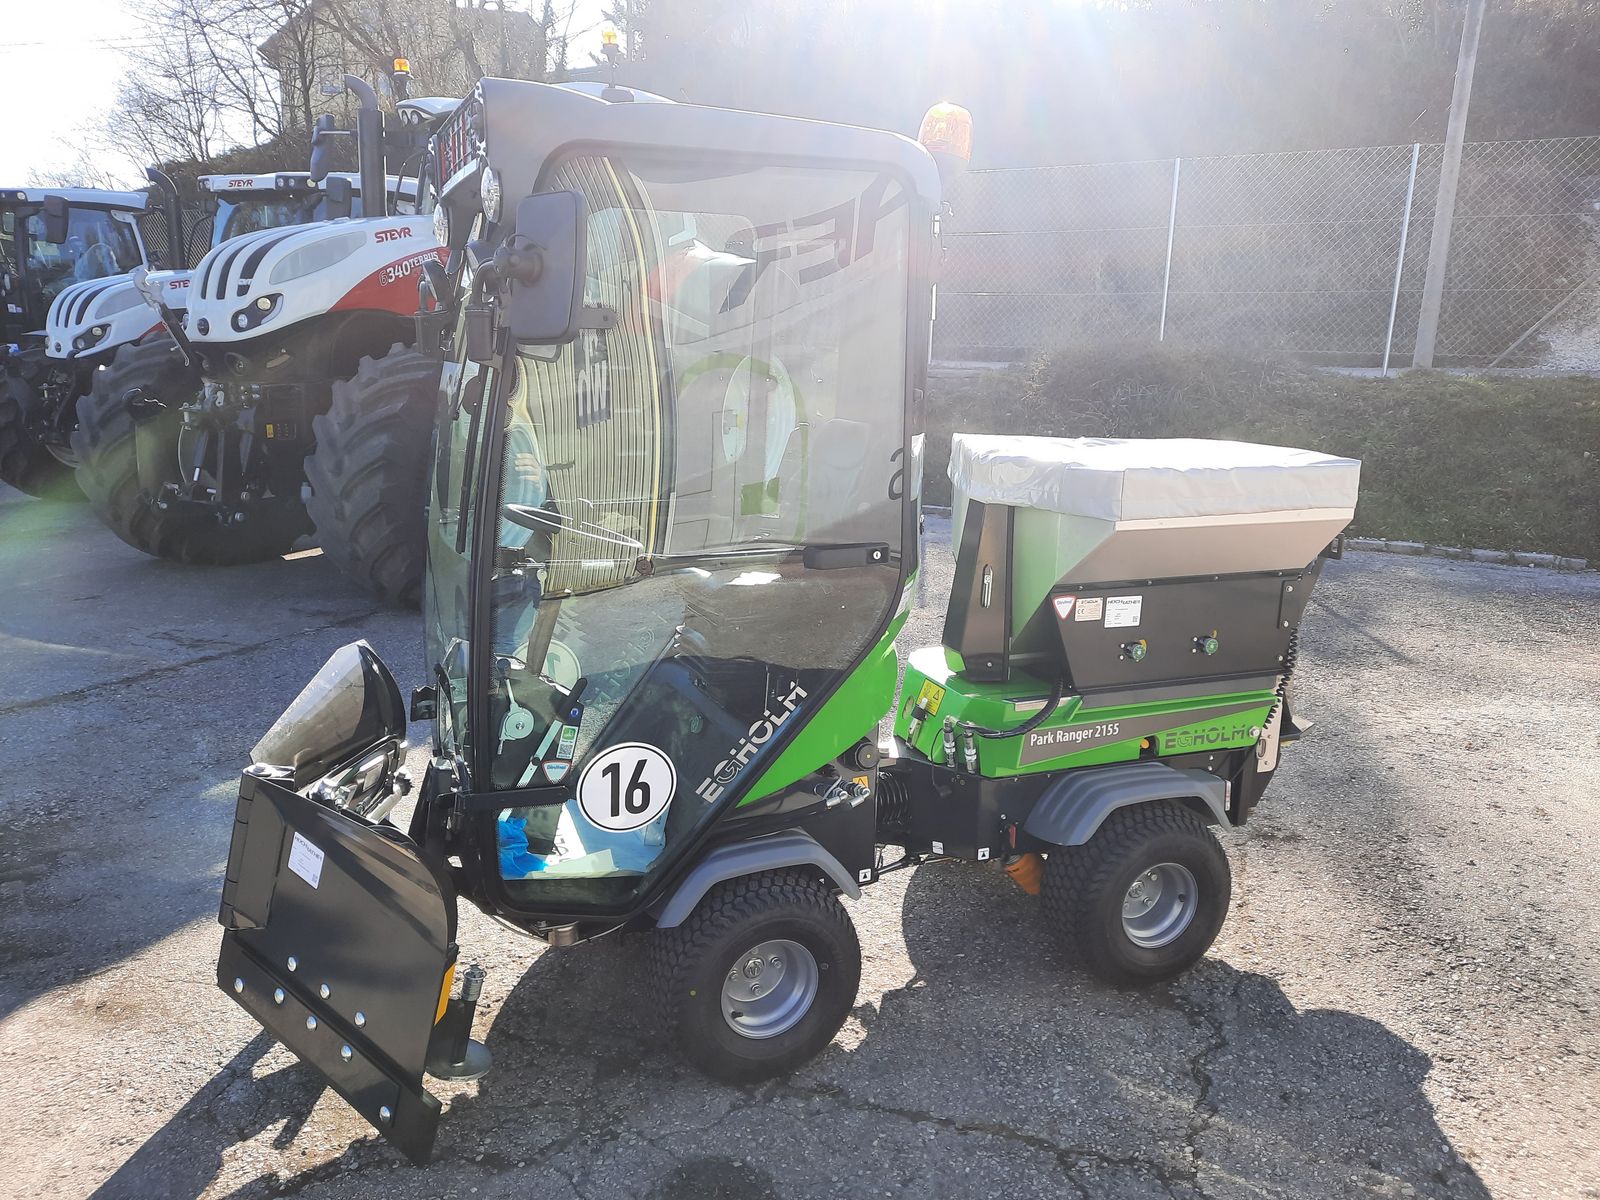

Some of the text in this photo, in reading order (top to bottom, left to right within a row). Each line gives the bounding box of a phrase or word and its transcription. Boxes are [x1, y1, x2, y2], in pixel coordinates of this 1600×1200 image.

[228, 179, 253, 188] STEYR
[374, 227, 412, 243] STEYR
[169, 279, 190, 289] STE
[379, 260, 411, 287] 6340
[695, 681, 808, 804] EGHOLM
[1030, 723, 1120, 747] Park Ranger 2155
[1165, 724, 1246, 749] EGHOLM
[602, 759, 650, 817] 16
